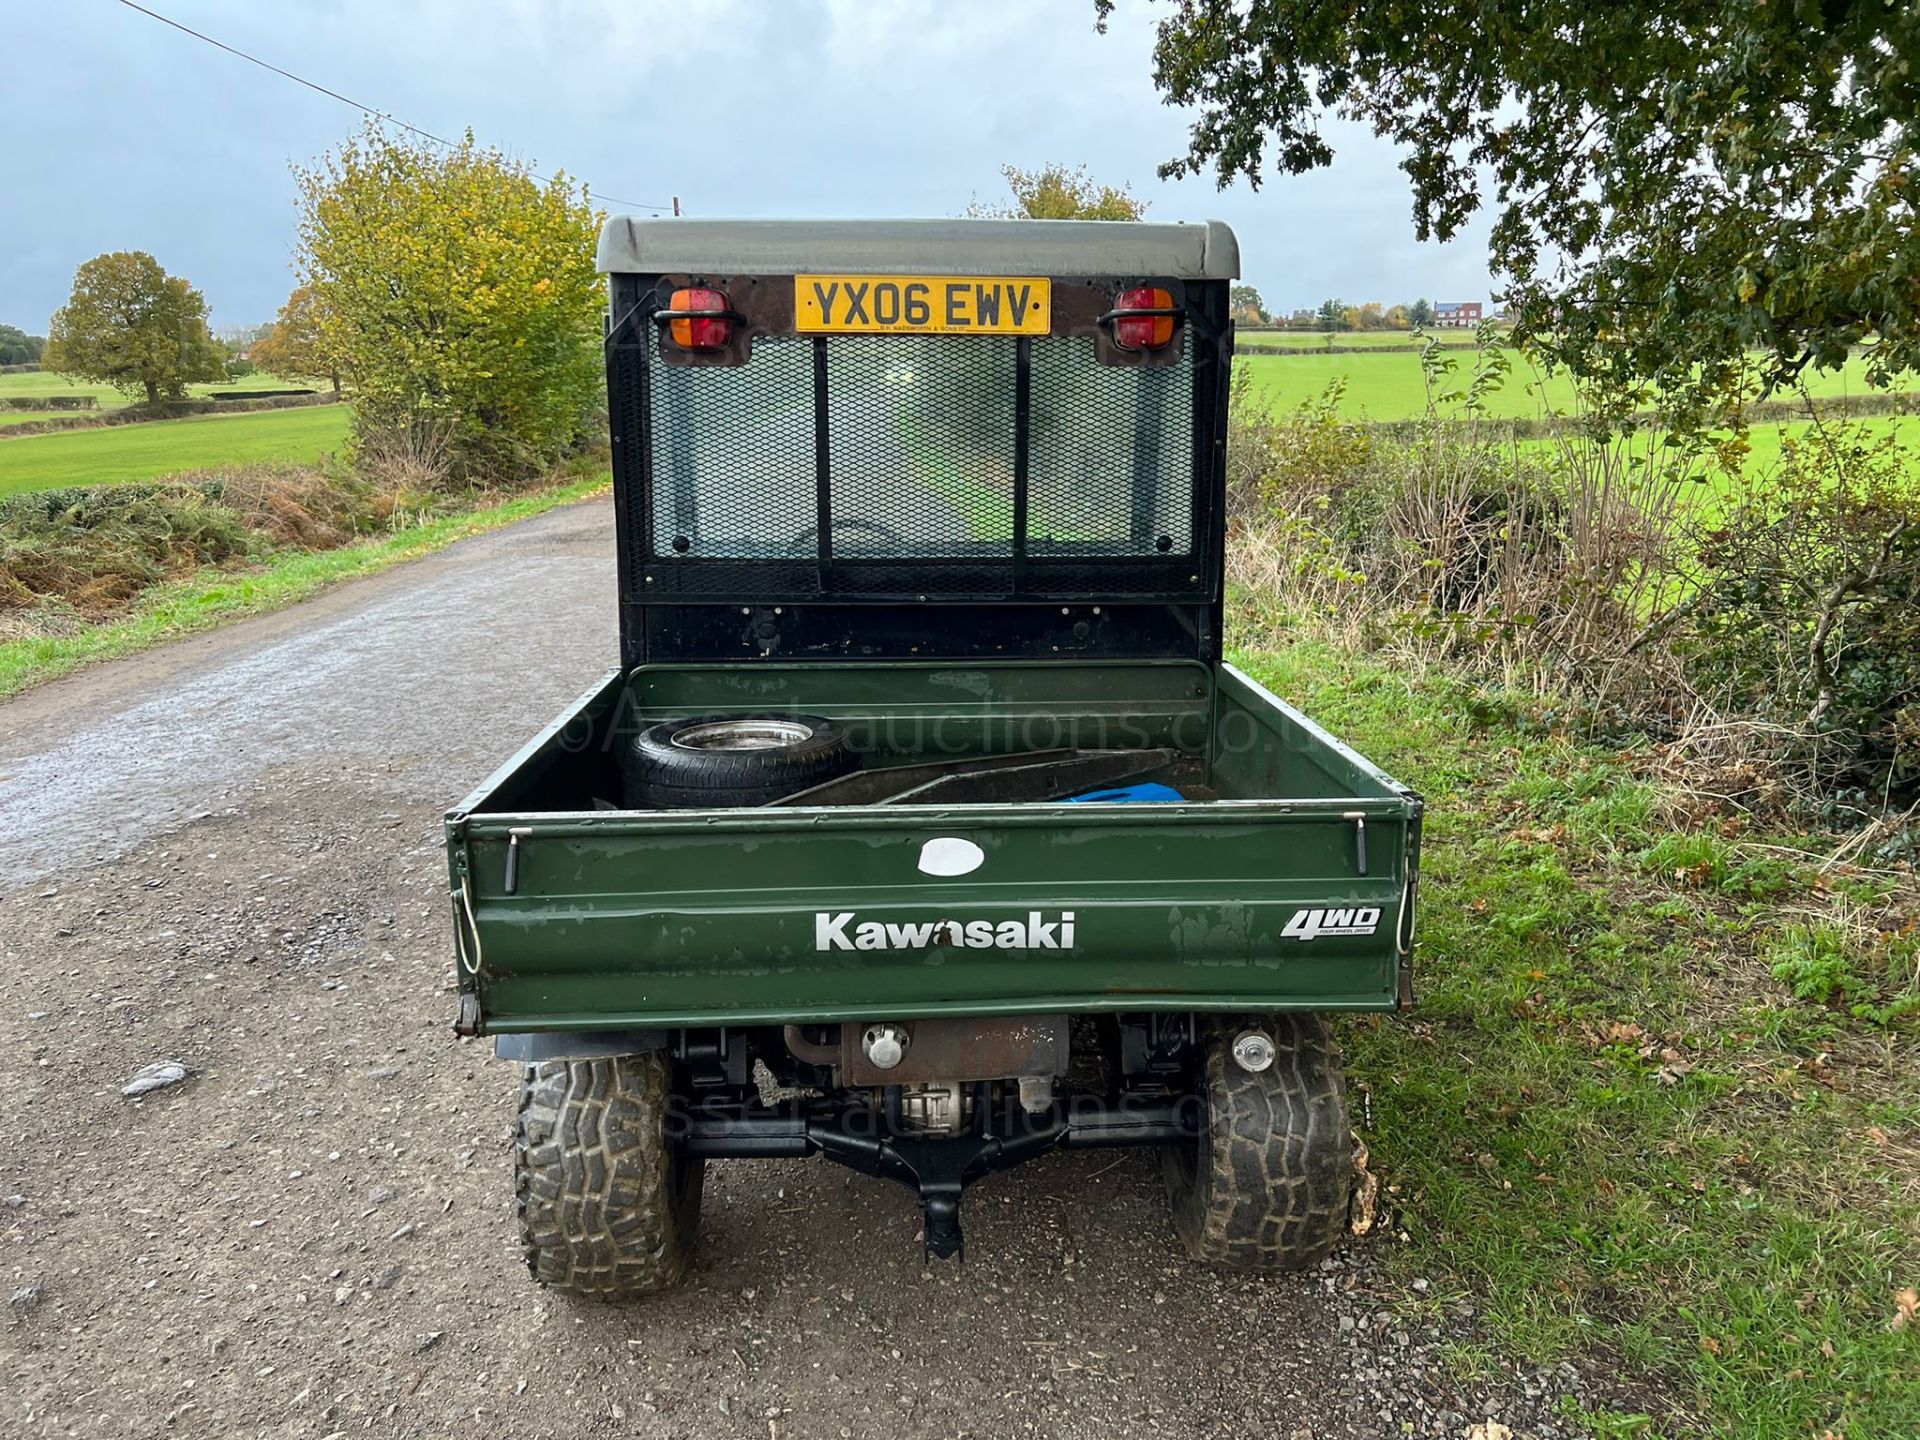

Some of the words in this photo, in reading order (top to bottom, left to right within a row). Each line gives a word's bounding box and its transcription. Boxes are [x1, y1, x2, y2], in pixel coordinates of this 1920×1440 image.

[813, 282, 930, 325] YX06
[945, 283, 1031, 326] EWV
[815, 911, 1075, 950] Kawasaki
[1280, 908, 1380, 940] 4WD
